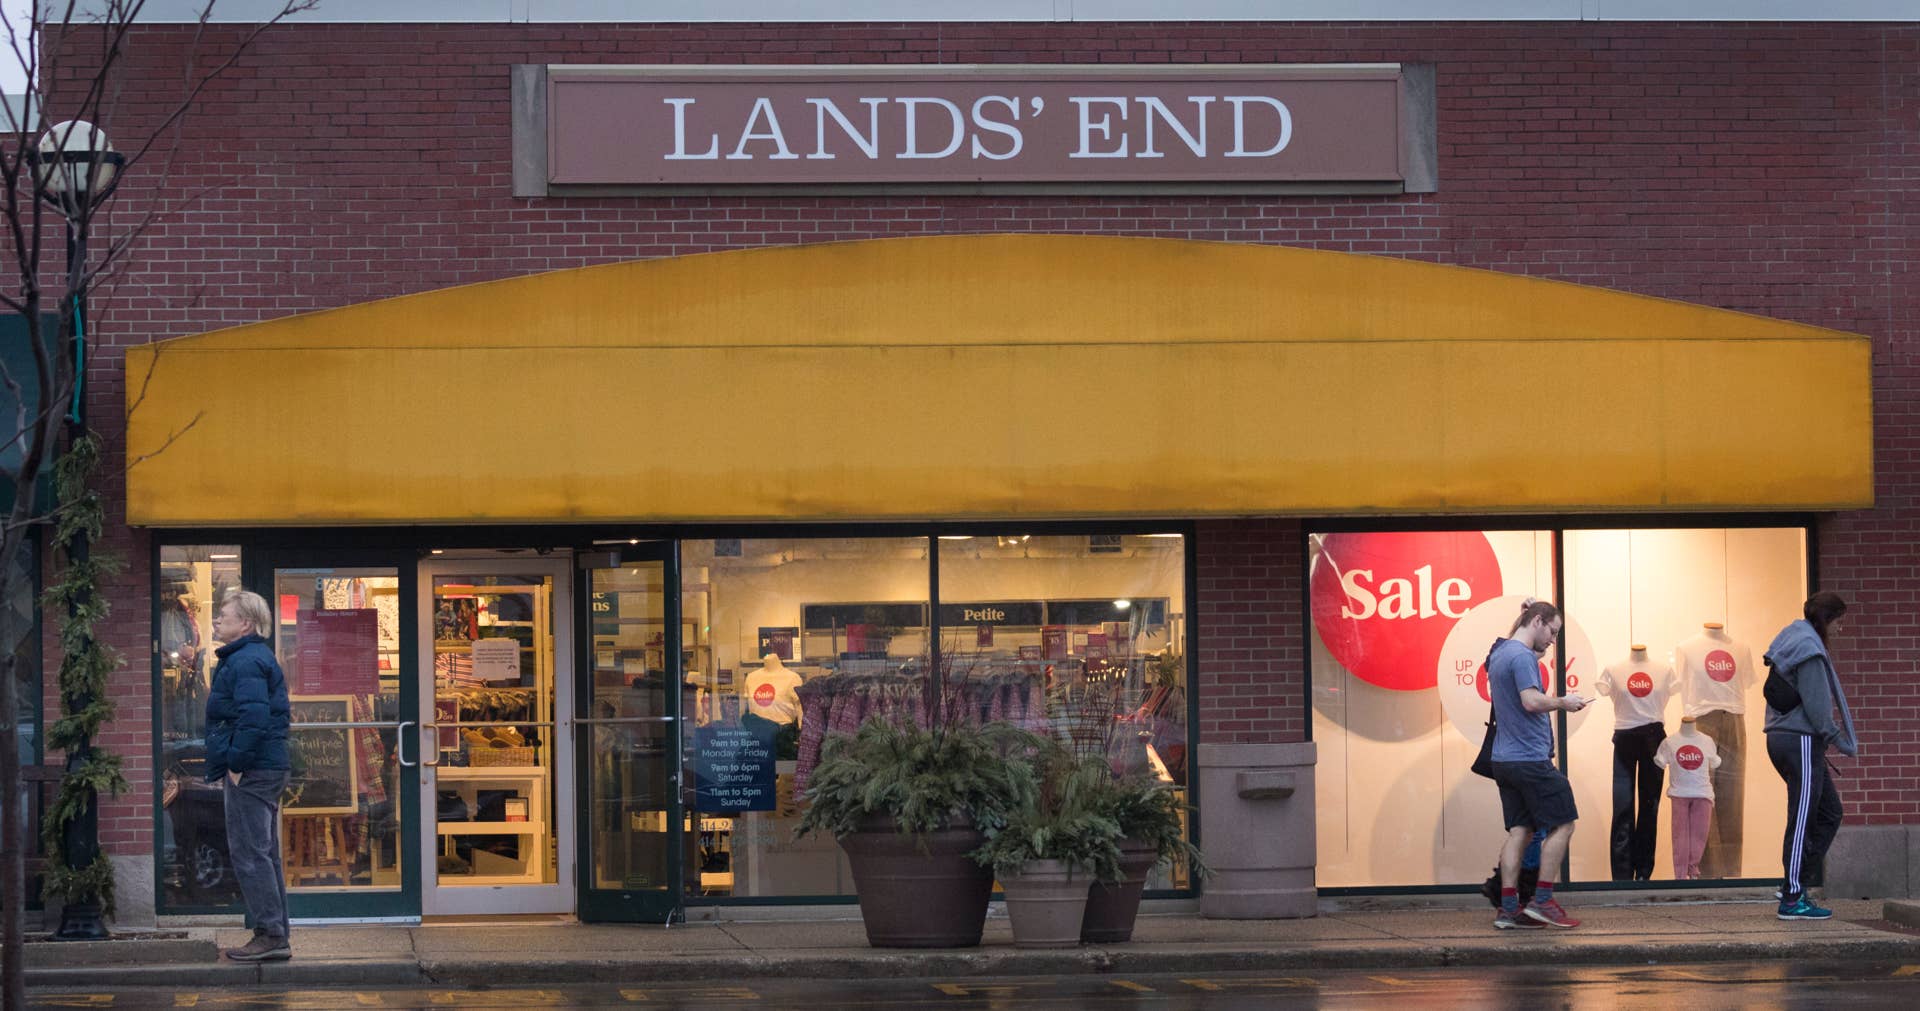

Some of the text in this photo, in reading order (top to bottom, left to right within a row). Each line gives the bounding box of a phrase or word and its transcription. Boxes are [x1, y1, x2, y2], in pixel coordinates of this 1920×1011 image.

[663, 95, 1292, 160] LANDS' END
[1341, 564, 1471, 620] Sale
[963, 607, 1005, 621] Petite
[1455, 660, 1473, 672] UP
[1708, 660, 1733, 672] Sale
[1455, 673, 1474, 686] TO
[1629, 679, 1651, 690] Sale
[756, 691, 773, 699] Sale
[710, 738, 760, 749] 9am to 8pm
[702, 749, 736, 760] Monday
[744, 748, 769, 759] Friday
[1678, 752, 1701, 763] Sale
[711, 763, 760, 773] 9am to 6pm
[718, 773, 754, 784] Saturday
[710, 787, 762, 798] 11am to 5pm
[720, 798, 752, 808] Sunday
